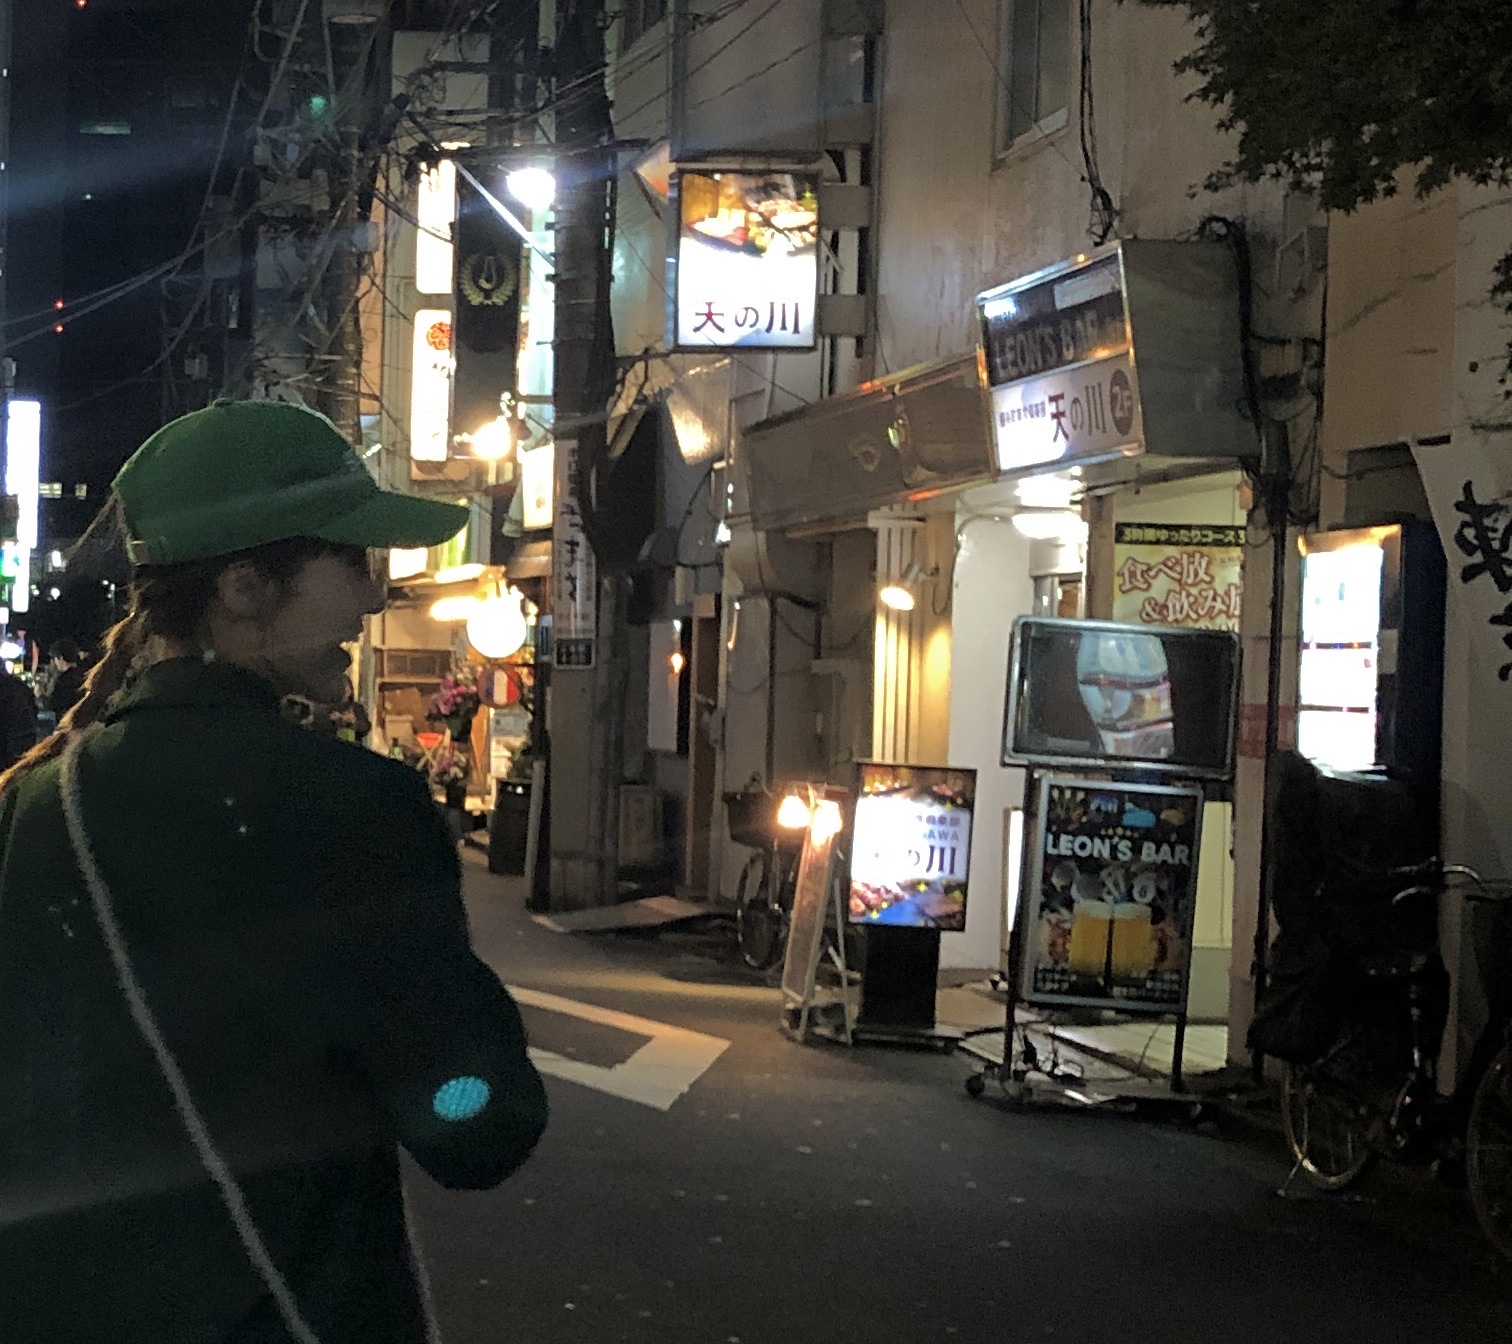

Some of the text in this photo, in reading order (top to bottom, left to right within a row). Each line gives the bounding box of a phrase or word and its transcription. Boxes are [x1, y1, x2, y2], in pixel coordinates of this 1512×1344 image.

[692, 300, 801, 335] 天の川
[1048, 382, 1108, 443] 天の川
[1112, 385, 1133, 419] 2F
[1046, 831, 1192, 865] LEON'S BAR
